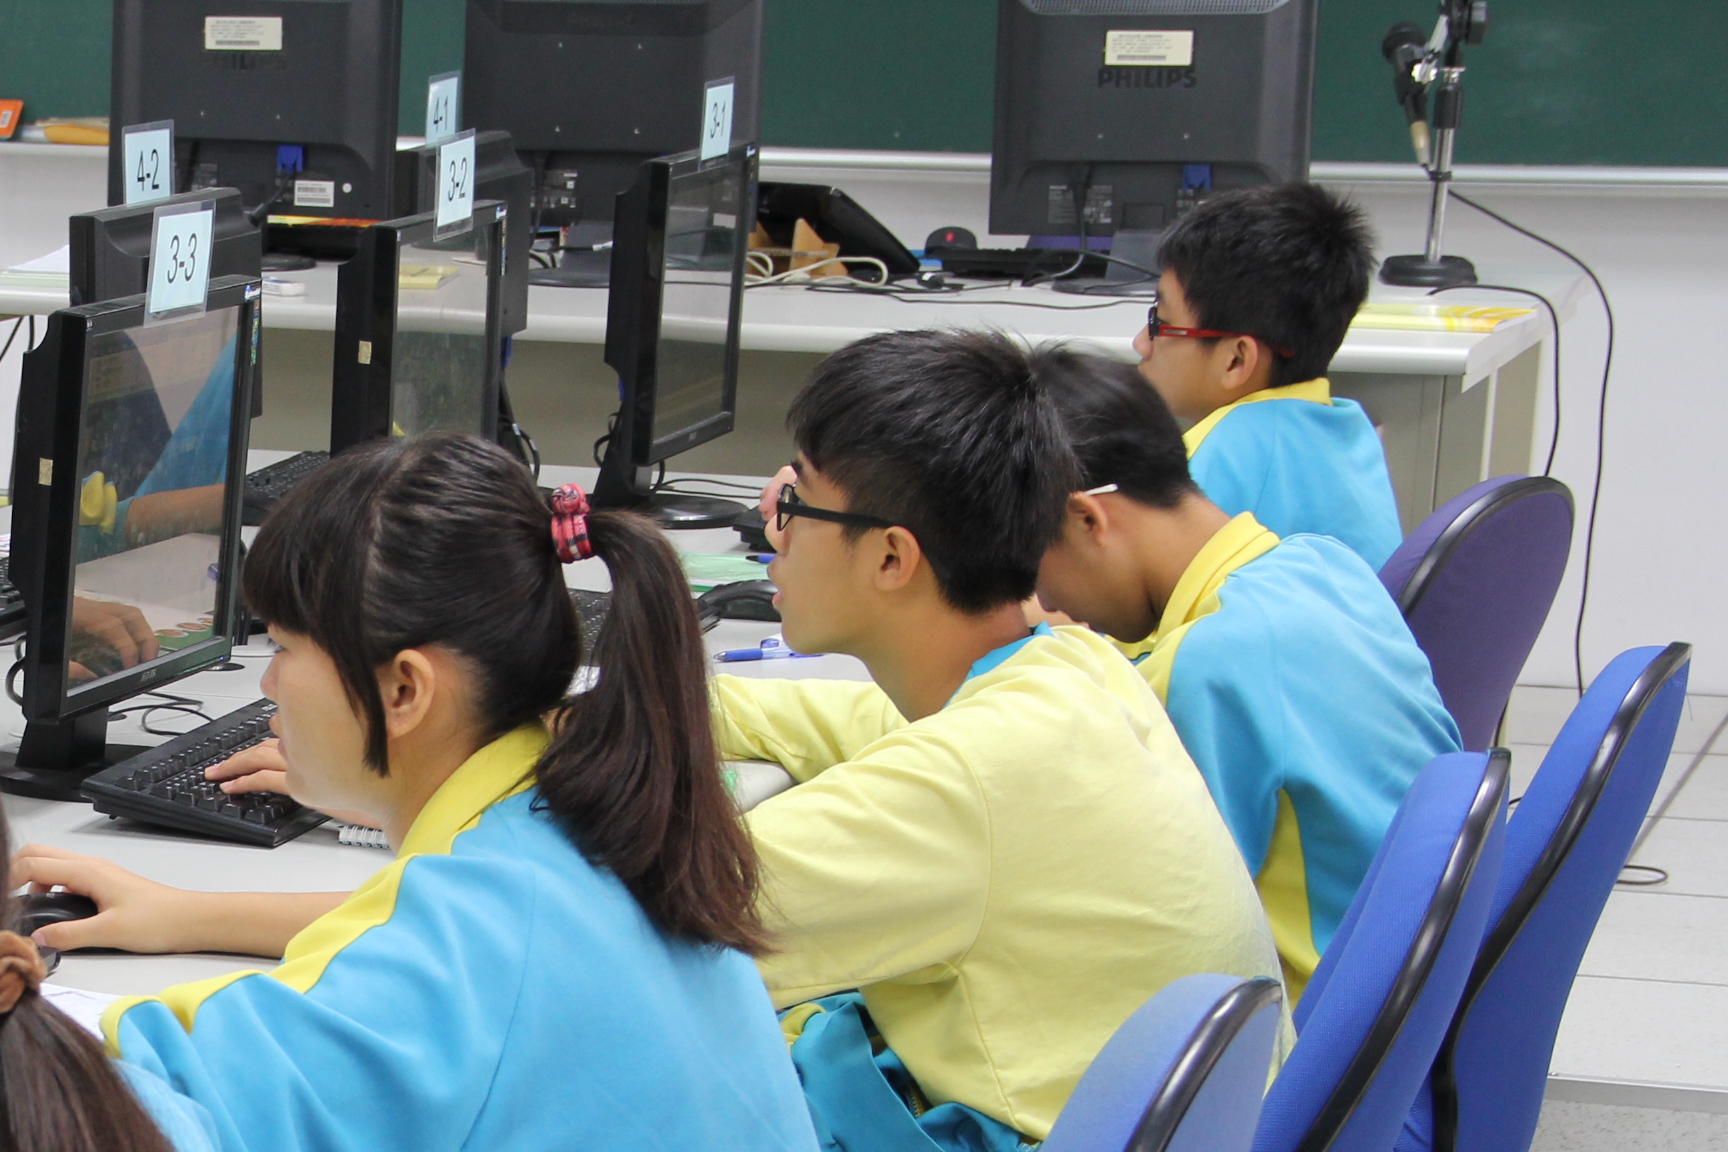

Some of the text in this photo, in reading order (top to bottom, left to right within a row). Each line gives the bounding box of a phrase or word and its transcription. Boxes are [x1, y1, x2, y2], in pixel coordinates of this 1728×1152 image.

[1098, 67, 1197, 88] PHILIPS
[432, 96, 449, 129] 4-1
[710, 102, 727, 139] 3-1
[137, 148, 160, 190] 4-2
[447, 156, 468, 203] 3-2
[167, 232, 198, 284] 3-3
